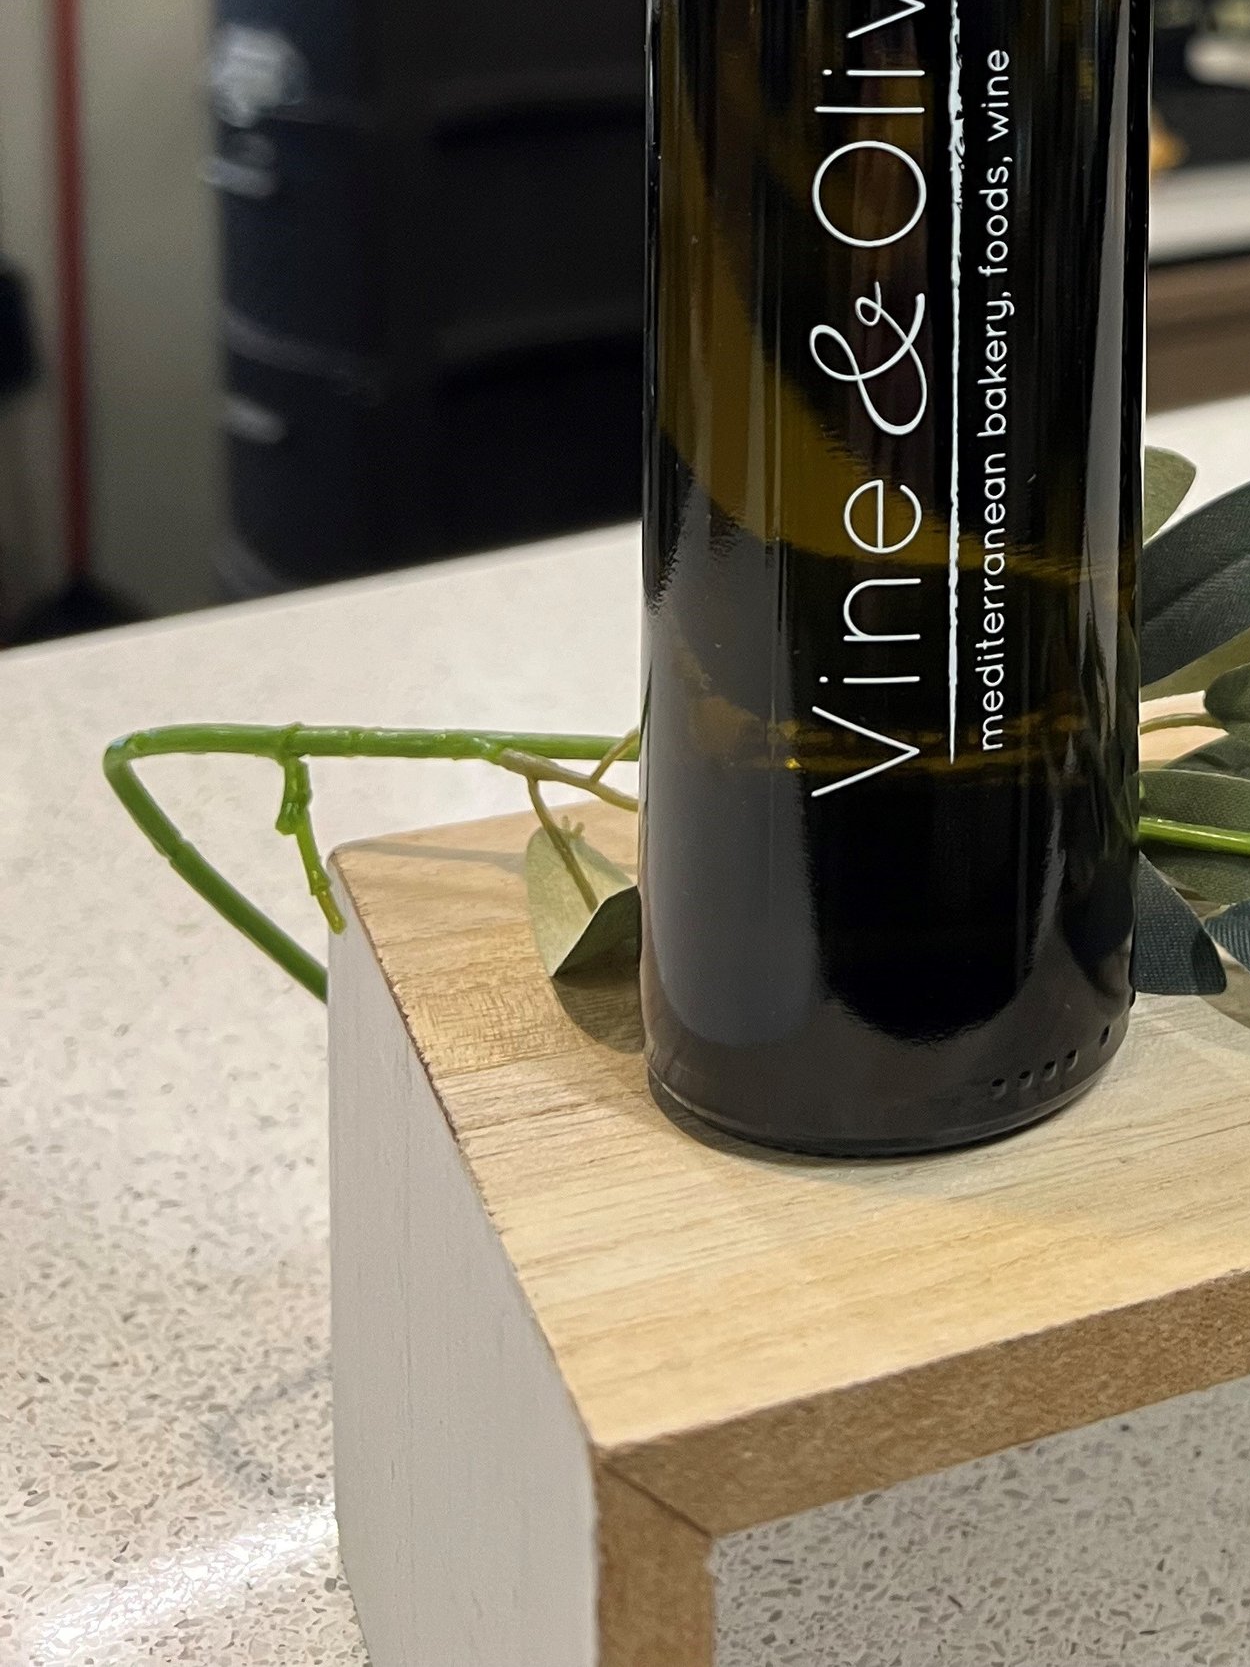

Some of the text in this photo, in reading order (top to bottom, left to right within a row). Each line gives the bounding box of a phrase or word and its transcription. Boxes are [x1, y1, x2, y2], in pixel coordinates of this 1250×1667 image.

[809, 280, 928, 437] &
[974, 48, 1015, 752] mediterranean bakery, foods, wine
[811, 479, 922, 798] Vine
